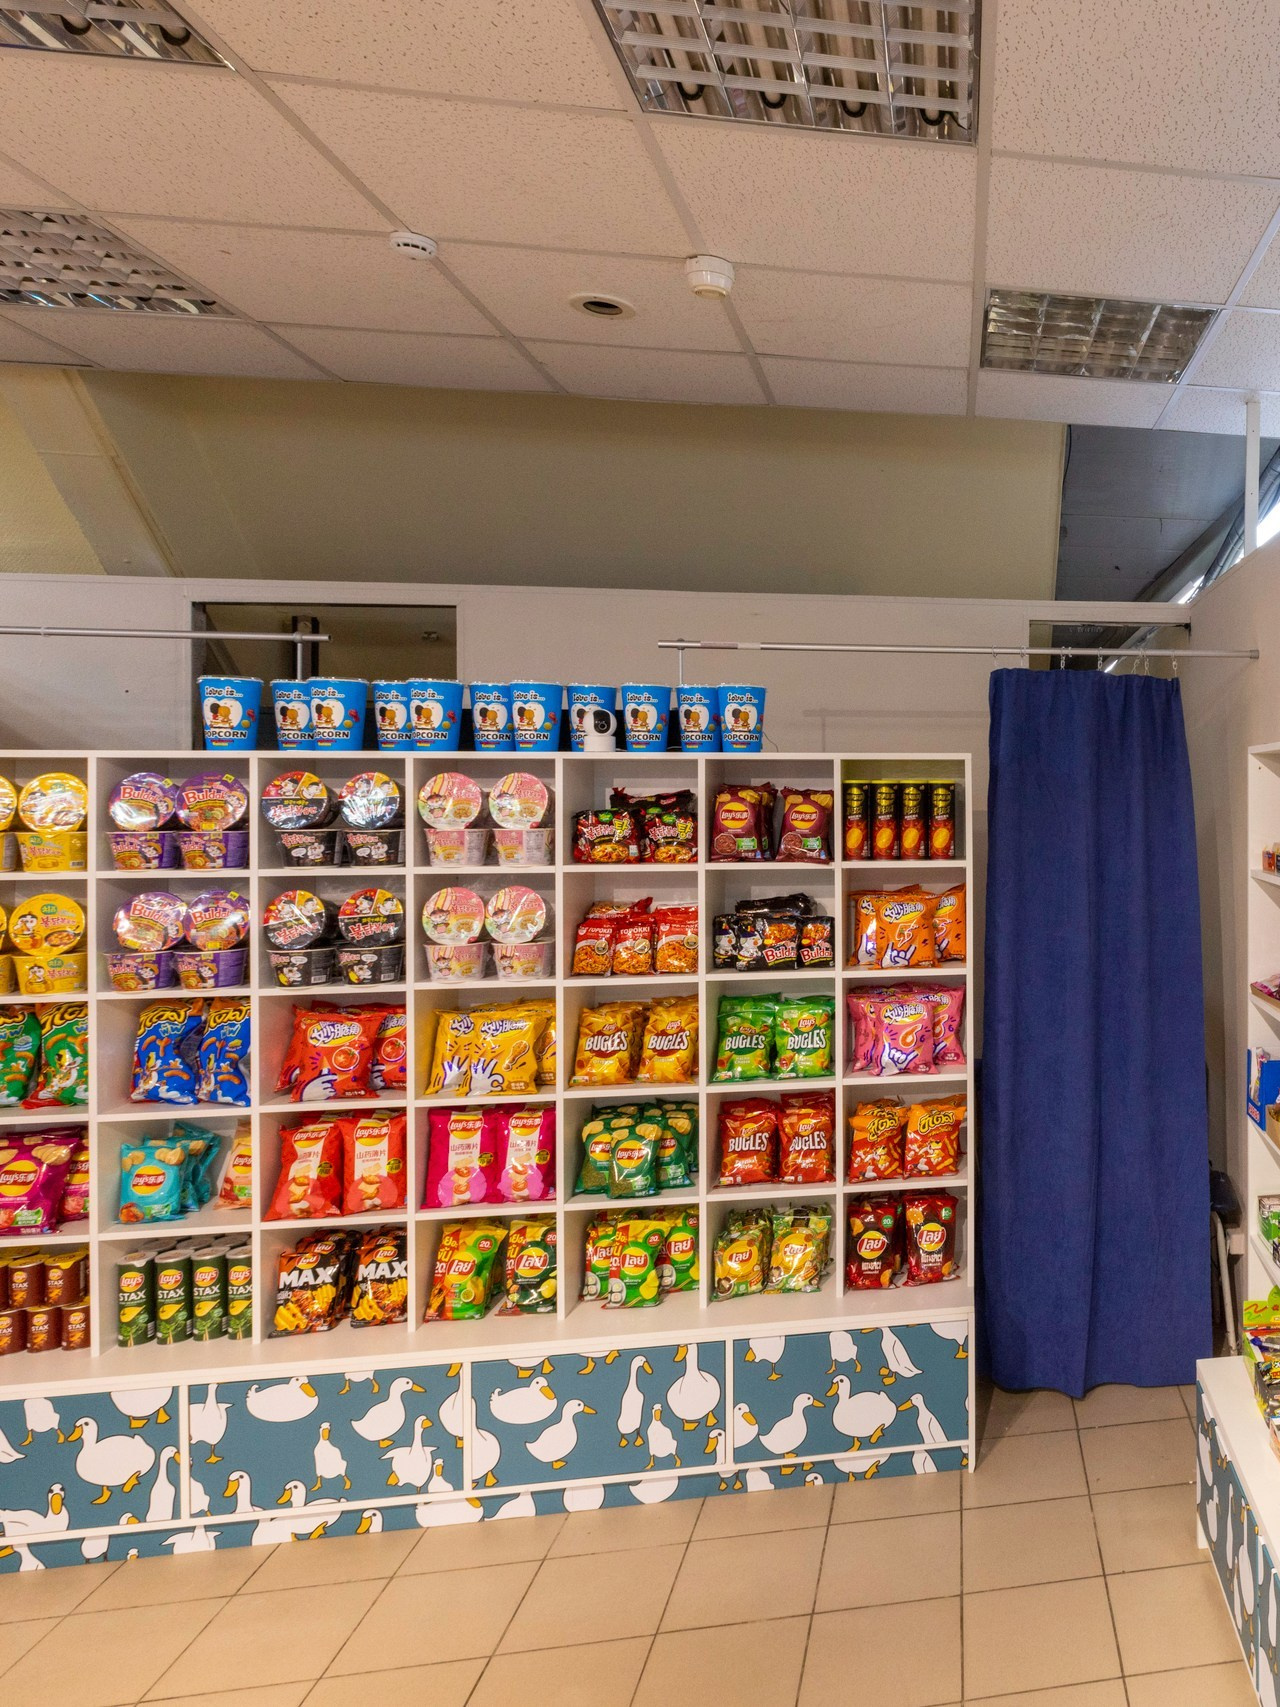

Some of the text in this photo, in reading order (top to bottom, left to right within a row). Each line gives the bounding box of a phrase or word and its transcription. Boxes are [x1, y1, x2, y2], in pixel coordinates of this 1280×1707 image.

[724, 733, 760, 742] POPCORN
[182, 789, 226, 805] Buldak
[585, 1031, 628, 1052] BUGLES
[647, 1031, 689, 1050] BUGLES
[725, 1034, 765, 1049] BUGLES
[787, 1029, 826, 1050] BUGLES
[1248, 1104, 1260, 1122] HARIBO
[728, 1132, 769, 1152] BUGLES
[789, 1131, 827, 1151] BUGLES
[671, 1238, 693, 1255] เลย์
[624, 1254, 647, 1268] เลย์
[279, 1265, 336, 1289] MAX
[358, 1260, 407, 1281] MAX
[47, 1279, 64, 1287] STAX
[194, 1284, 220, 1296] STAX
[228, 1284, 252, 1295] STAX
[119, 1289, 146, 1301] STAX
[158, 1287, 185, 1299] STAX
[31, 1324, 49, 1332] STAX
